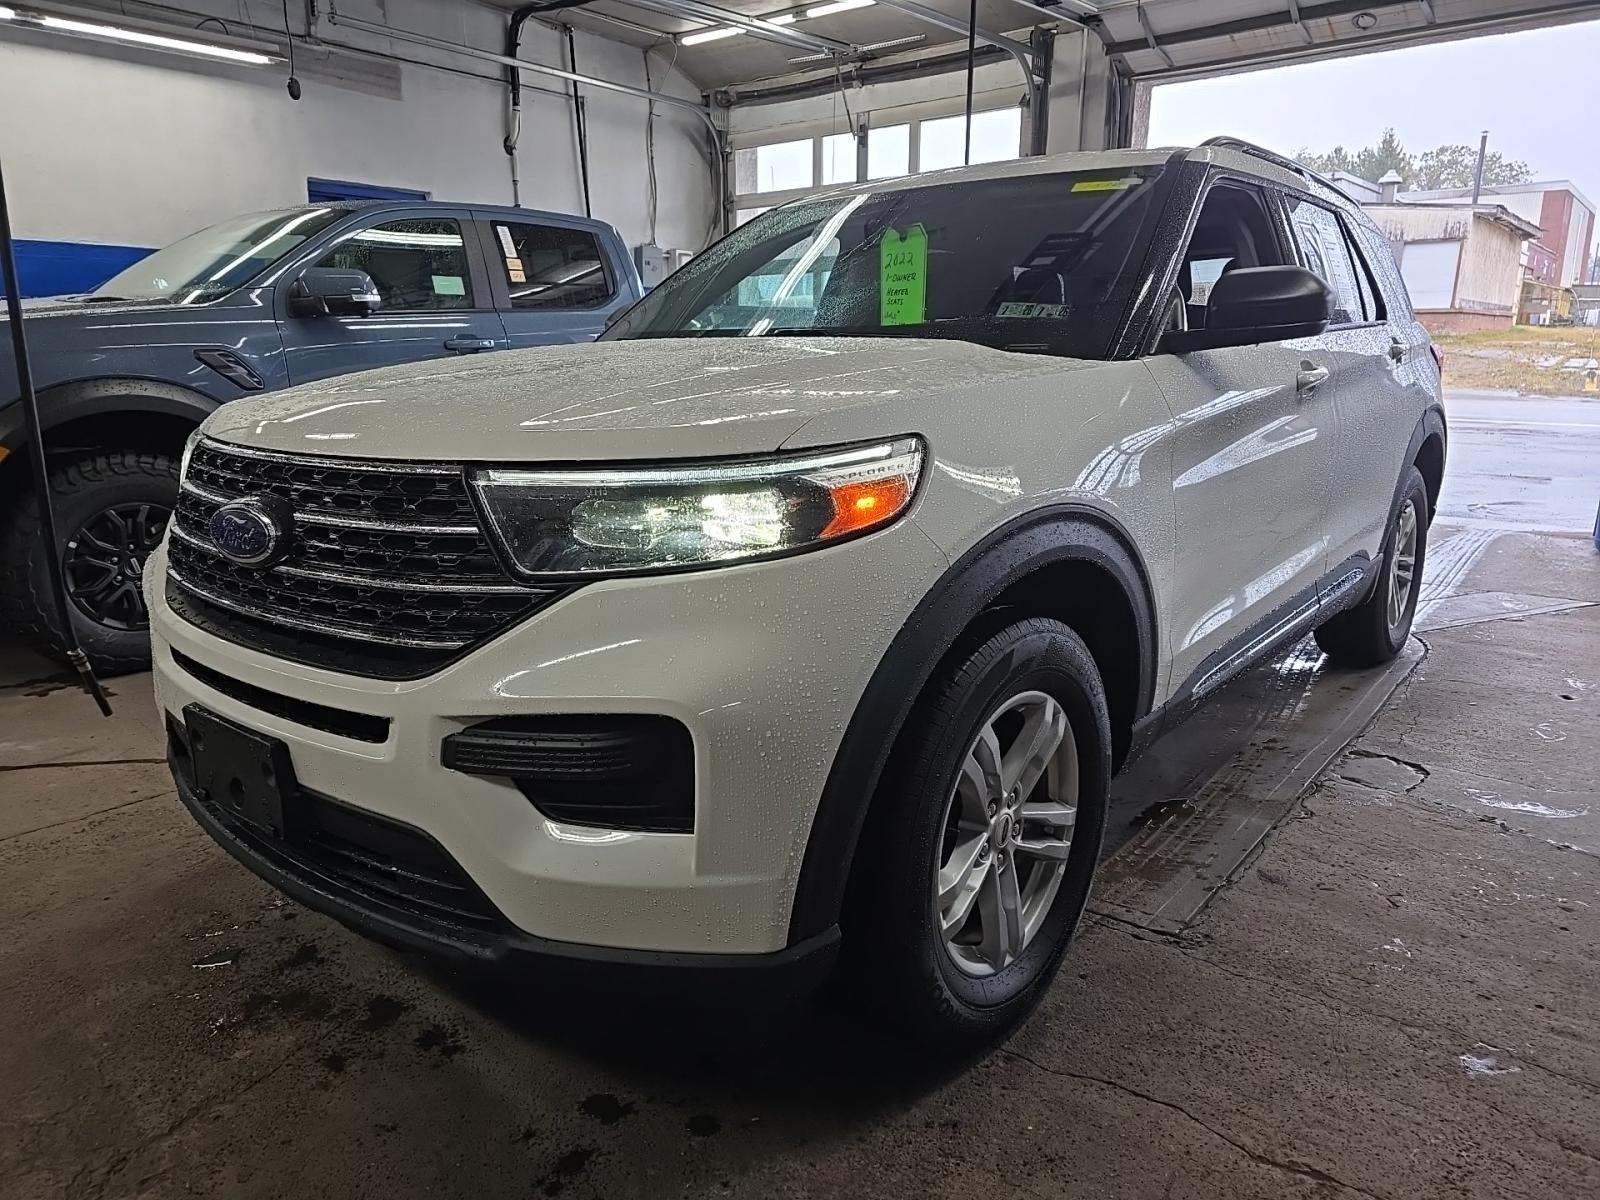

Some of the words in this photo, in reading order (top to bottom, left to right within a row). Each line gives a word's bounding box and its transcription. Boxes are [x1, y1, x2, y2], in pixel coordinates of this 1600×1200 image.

[884, 252, 914, 270] 2022
[887, 287, 909, 296] HEATED
[886, 298, 904, 306] SEATS
[828, 463, 904, 480] EXPLORER
[220, 514, 261, 551] Ford
